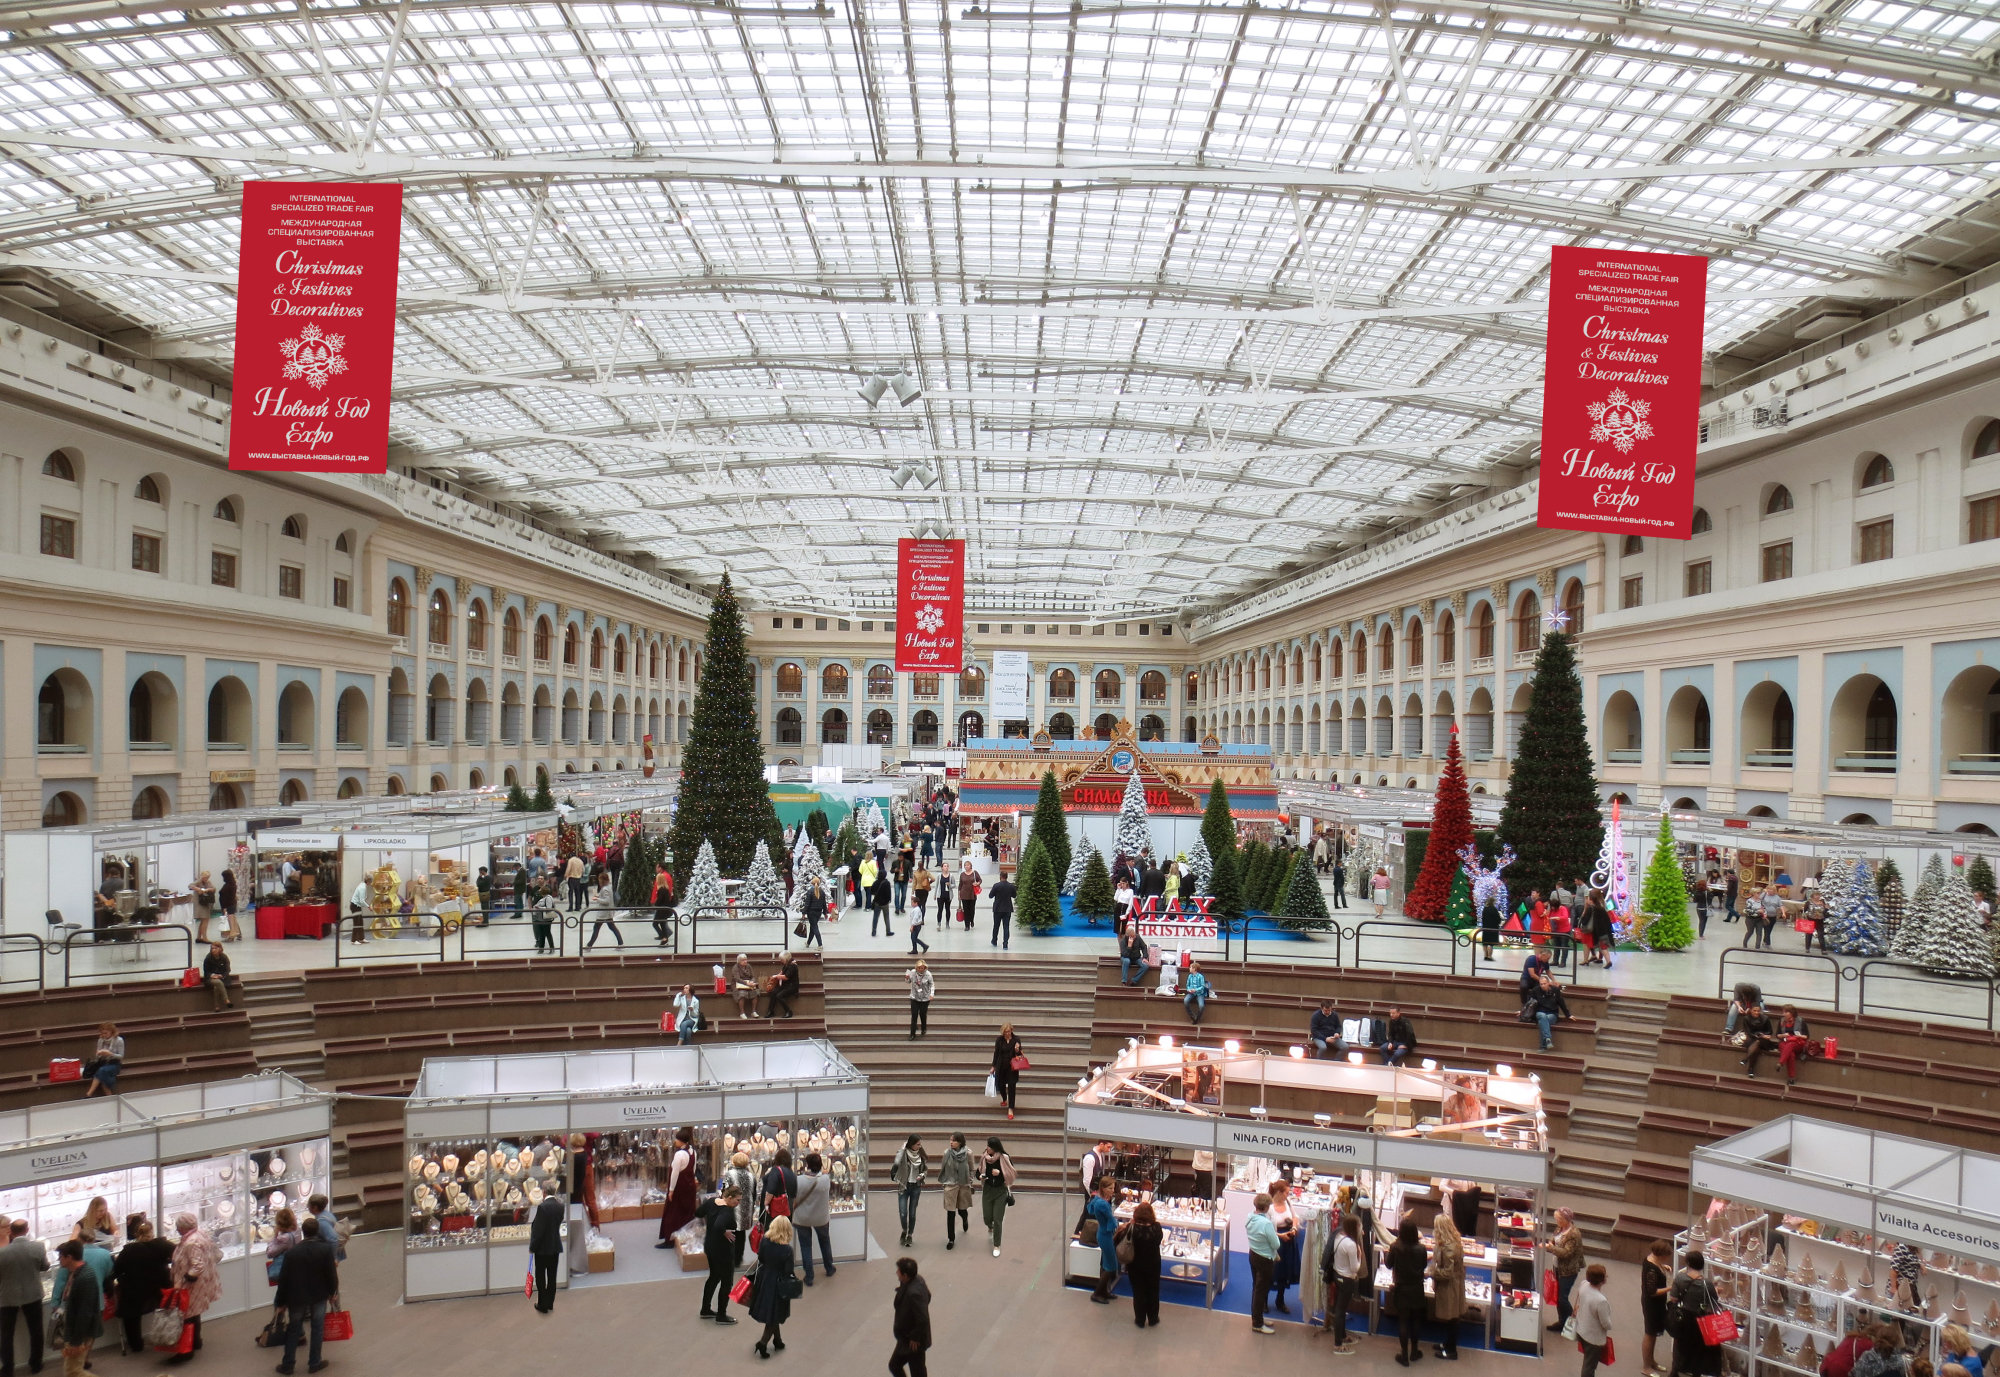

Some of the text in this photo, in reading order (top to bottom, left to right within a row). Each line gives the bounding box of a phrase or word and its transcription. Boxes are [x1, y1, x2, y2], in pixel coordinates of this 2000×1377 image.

[271, 204, 324, 212] SPECIALIZED
[355, 205, 374, 213] FAIR
[281, 219, 362, 228] МЕЖДУНАРОДНАЯ
[268, 229, 374, 237] СПЕЦИАЛИЗИРОВАННАЯ
[275, 250, 363, 276] Christmas
[1596, 261, 1662, 272] INTERNATIONAL
[1578, 269, 1679, 283] SPECIALIZED TRADE FAIR
[274, 278, 353, 296] & Festives
[1588, 284, 1668, 297] МЕЖДУНАРОДНАЯ
[269, 299, 364, 317] Decoratives
[1575, 293, 1680, 307] СПЕЦИАЛИЗИРОВАННАЯ
[1603, 305, 1650, 315] ВЫСТАВКА
[1583, 315, 1669, 344] Christmas
[1581, 343, 1659, 364] & Festives
[1578, 362, 1670, 385] Decoratives
[253, 387, 370, 419] Новый Год
[286, 422, 333, 450] Expo
[248, 452, 369, 462] WWW.ВЫСТАВКА-НОВЫЙ-ГОД.РФ
[1561, 448, 1676, 485] Новый Год
[1593, 484, 1640, 513] Expo
[1556, 511, 1675, 527] WWW.ВЫСТАВКА-НОВЫЙ-ГОД.РФ
[912, 569, 950, 581] Christmas
[919, 582, 945, 591] Festives
[911, 592, 950, 601] Decoratives
[904, 633, 955, 648] Новый Год
[919, 649, 940, 663] Expo
[1074, 788, 1122, 804] СИМА
[1128, 895, 1216, 923] MAX
[624, 1105, 667, 1115] UVELINA
[1233, 1132, 1356, 1156] NINA FORD (ИСПАНИЯ)
[31, 1151, 88, 1168] UVELINA
[1879, 1211, 2000, 1250] Vilalta Accesorios
